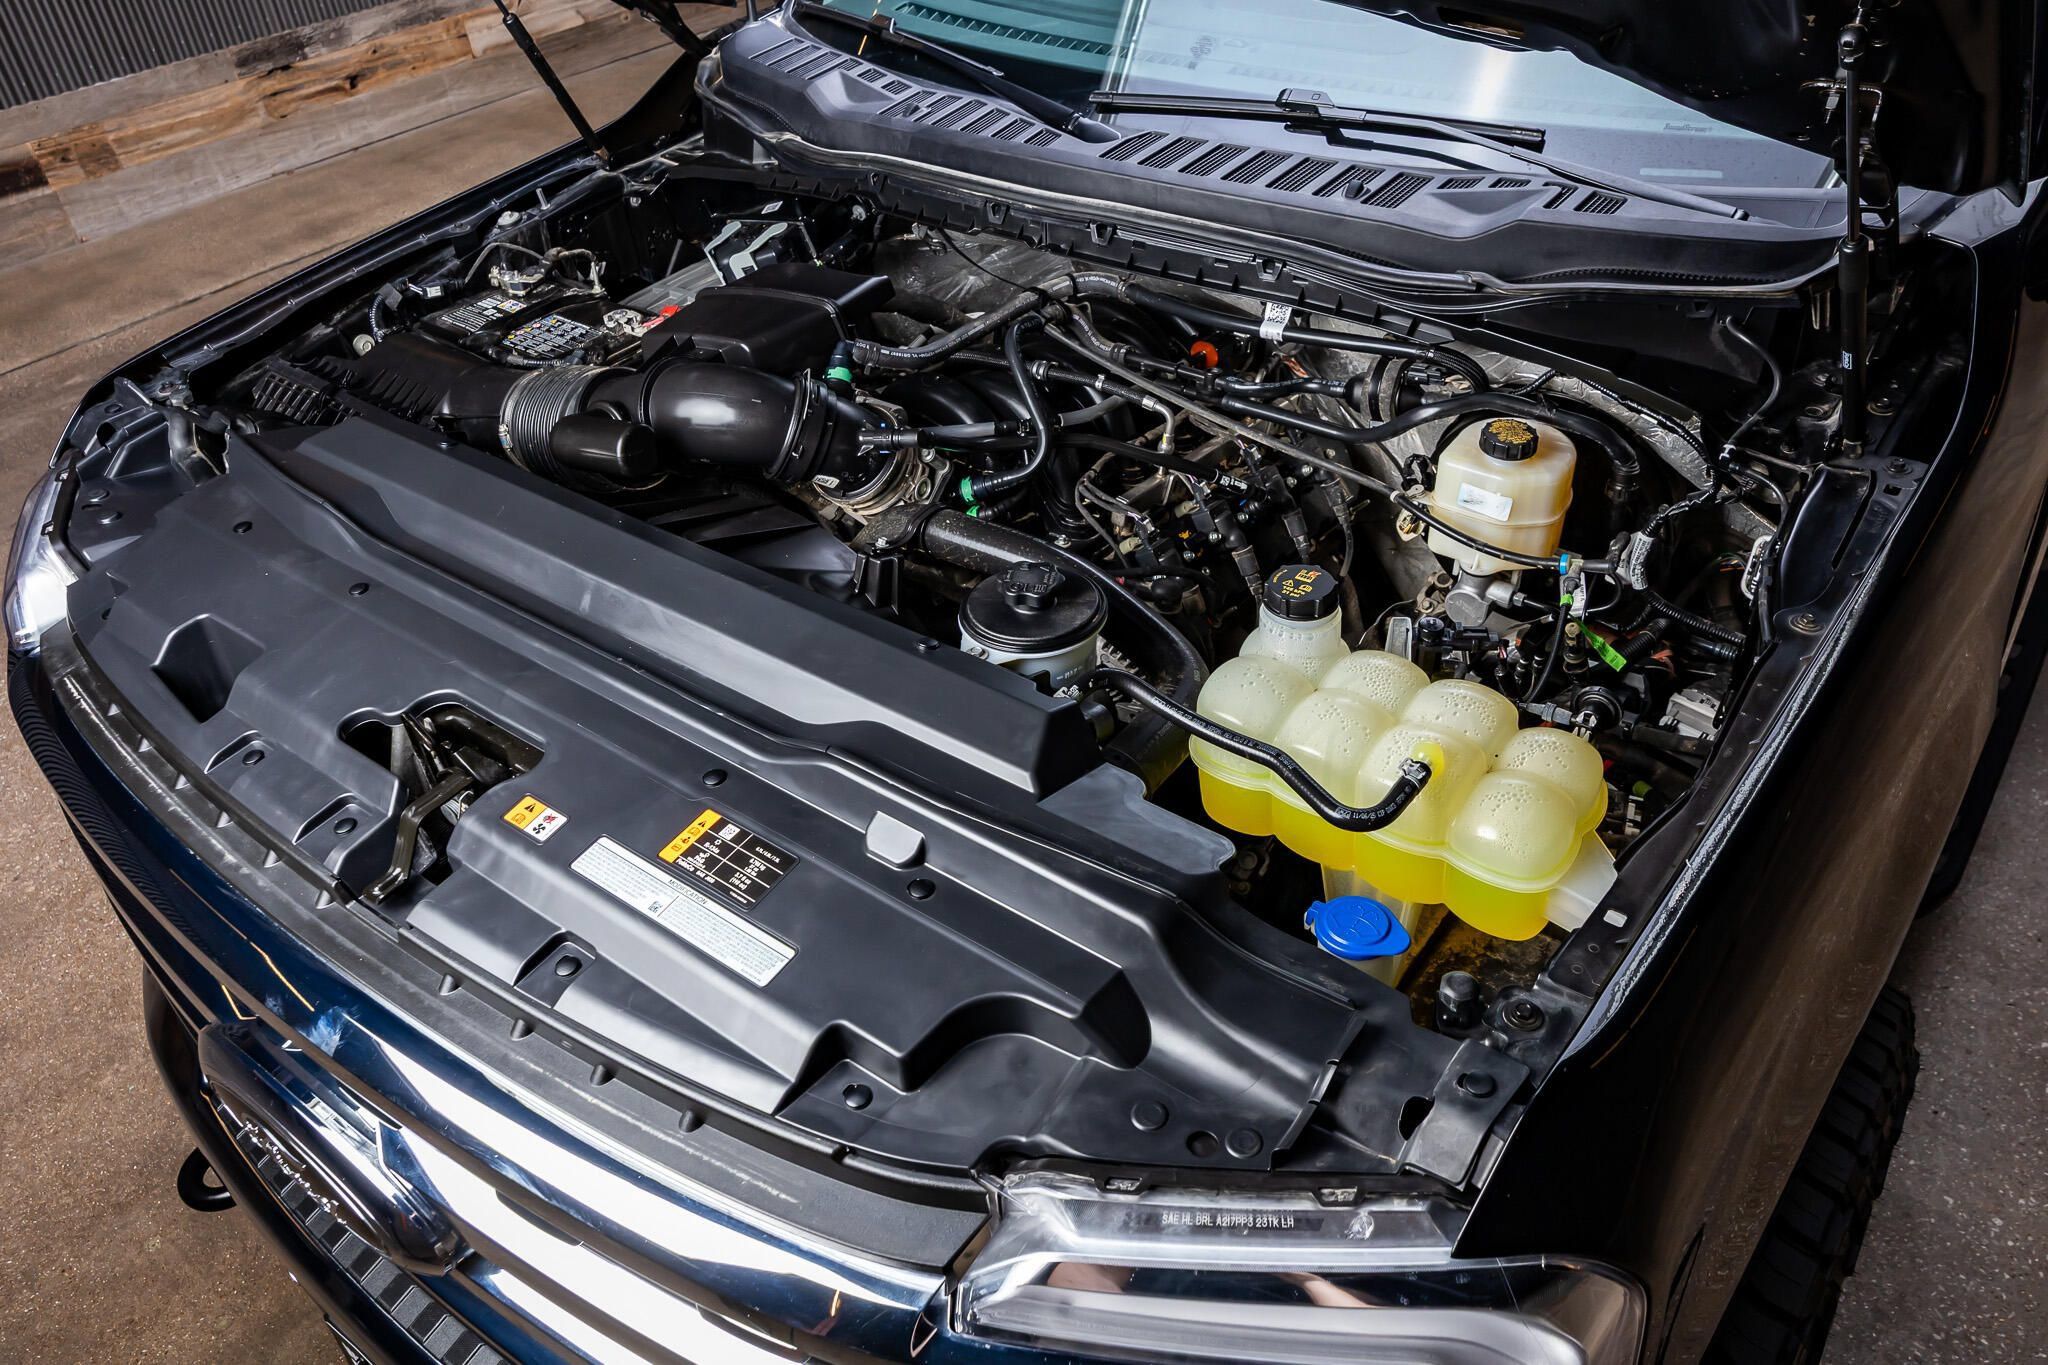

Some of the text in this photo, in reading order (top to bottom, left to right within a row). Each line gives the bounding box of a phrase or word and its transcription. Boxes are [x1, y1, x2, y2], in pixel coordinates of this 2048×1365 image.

[668, 879, 708, 905] MODIFICATION
[1161, 1213, 1179, 1225] SAE
[1181, 1214, 1194, 1226] HL
[1195, 1215, 1214, 1227] DRL
[1256, 1217, 1280, 1229] 23TK
[1282, 1217, 1295, 1229] LH
